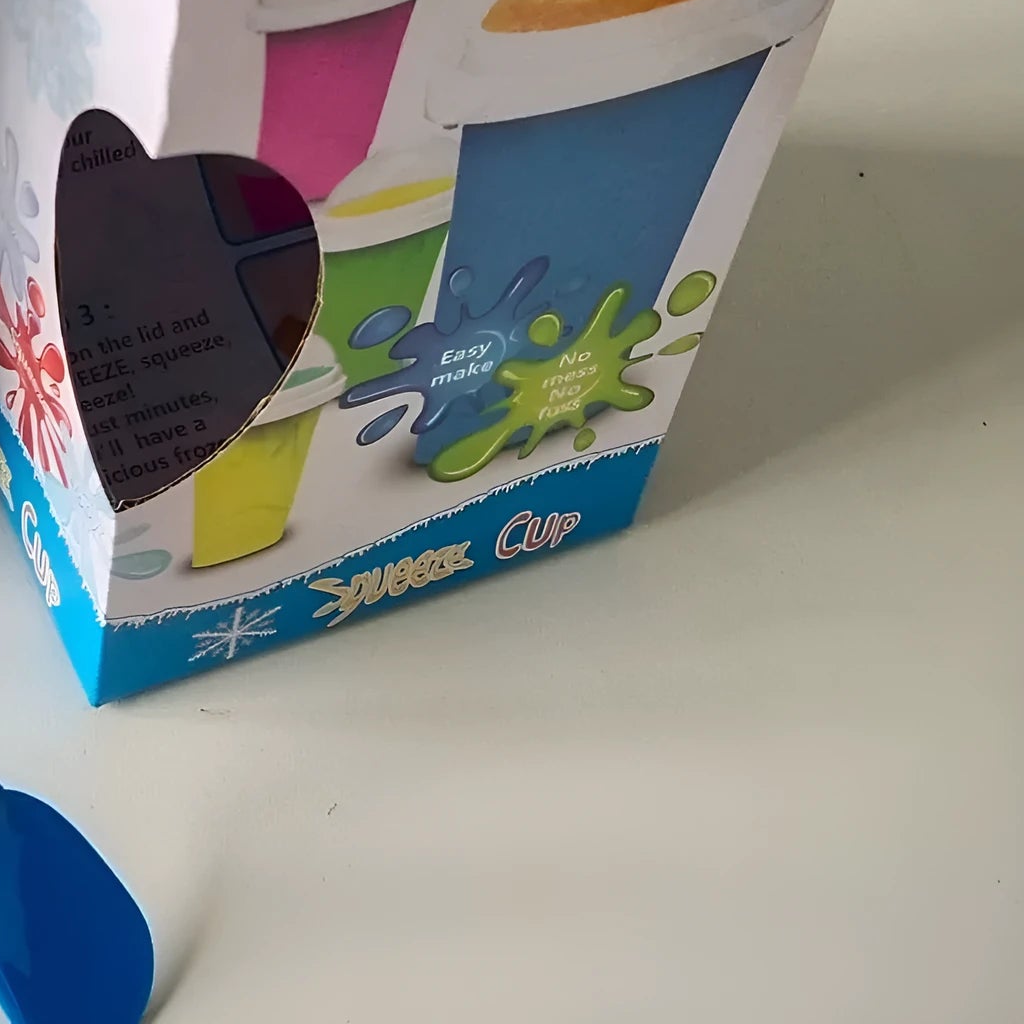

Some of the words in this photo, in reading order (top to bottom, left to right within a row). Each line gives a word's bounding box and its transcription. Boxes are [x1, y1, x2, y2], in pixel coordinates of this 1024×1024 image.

[71, 139, 136, 173] chilled
[98, 335, 133, 354] the
[137, 321, 165, 343] lid
[171, 308, 210, 334] and
[140, 334, 232, 370] squeeze,
[440, 341, 492, 366] Easy
[559, 351, 592, 369] No
[430, 360, 494, 388] make
[542, 363, 598, 389] mess
[126, 390, 219, 425] minutes,
[549, 384, 581, 402] No
[134, 424, 188, 449] have
[193, 419, 207, 432] a
[308, 540, 475, 628] Squeeze
[495, 509, 581, 560] Cup
